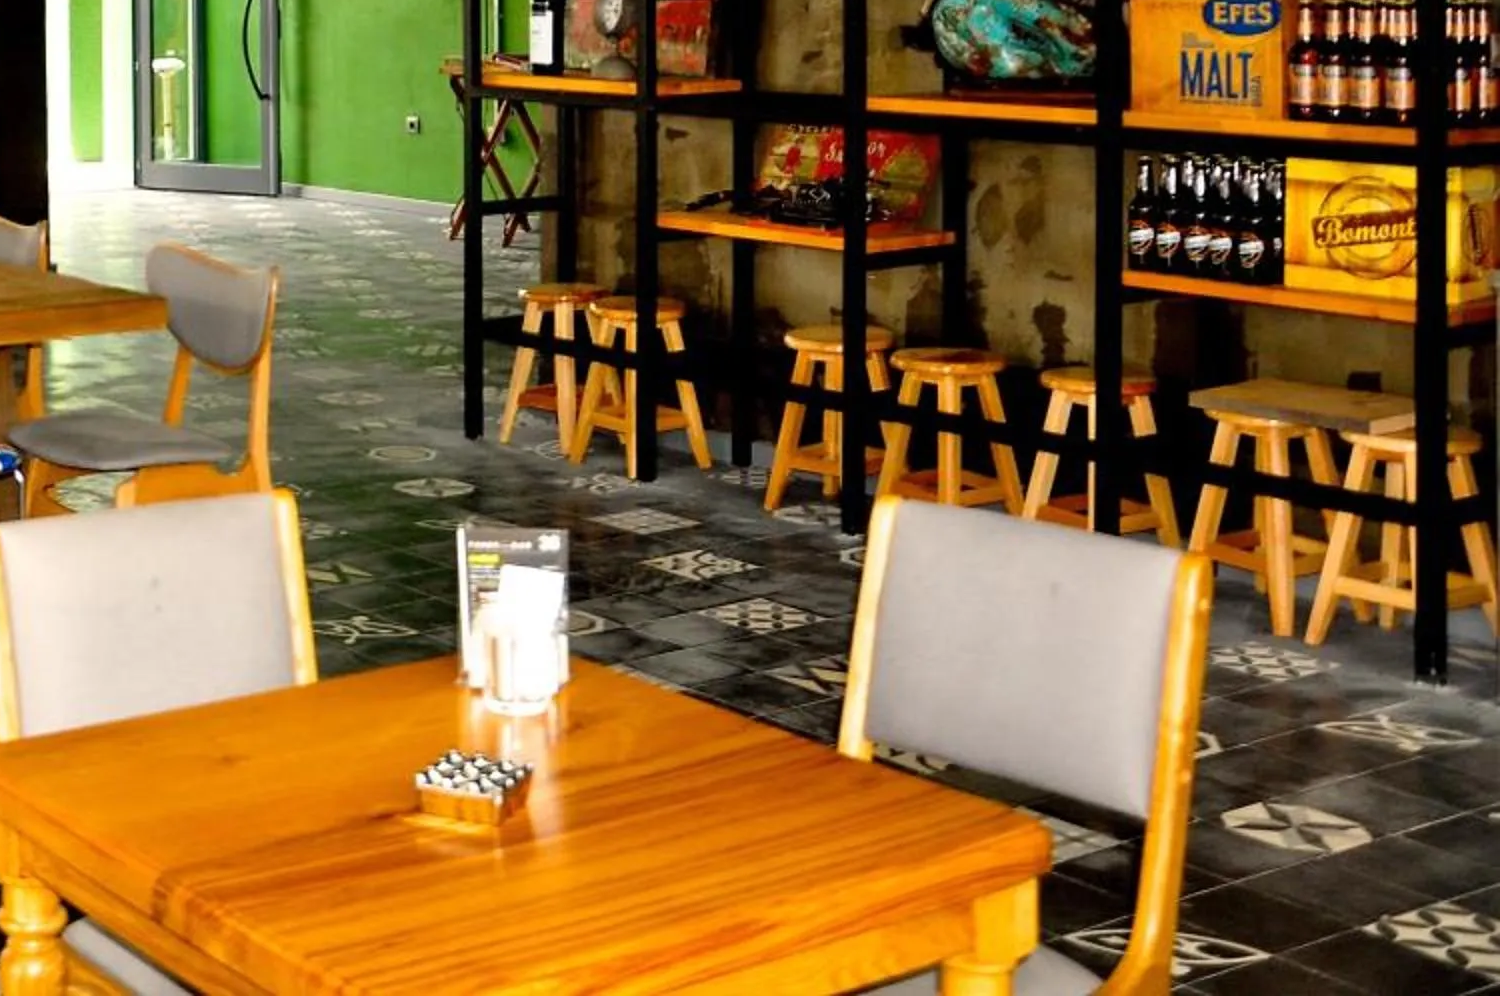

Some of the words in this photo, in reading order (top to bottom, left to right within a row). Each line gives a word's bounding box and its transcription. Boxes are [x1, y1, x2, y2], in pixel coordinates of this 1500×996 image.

[1212, 1, 1273, 25] EFES
[1180, 51, 1254, 99] MALT
[1316, 215, 1417, 246] Bomont
